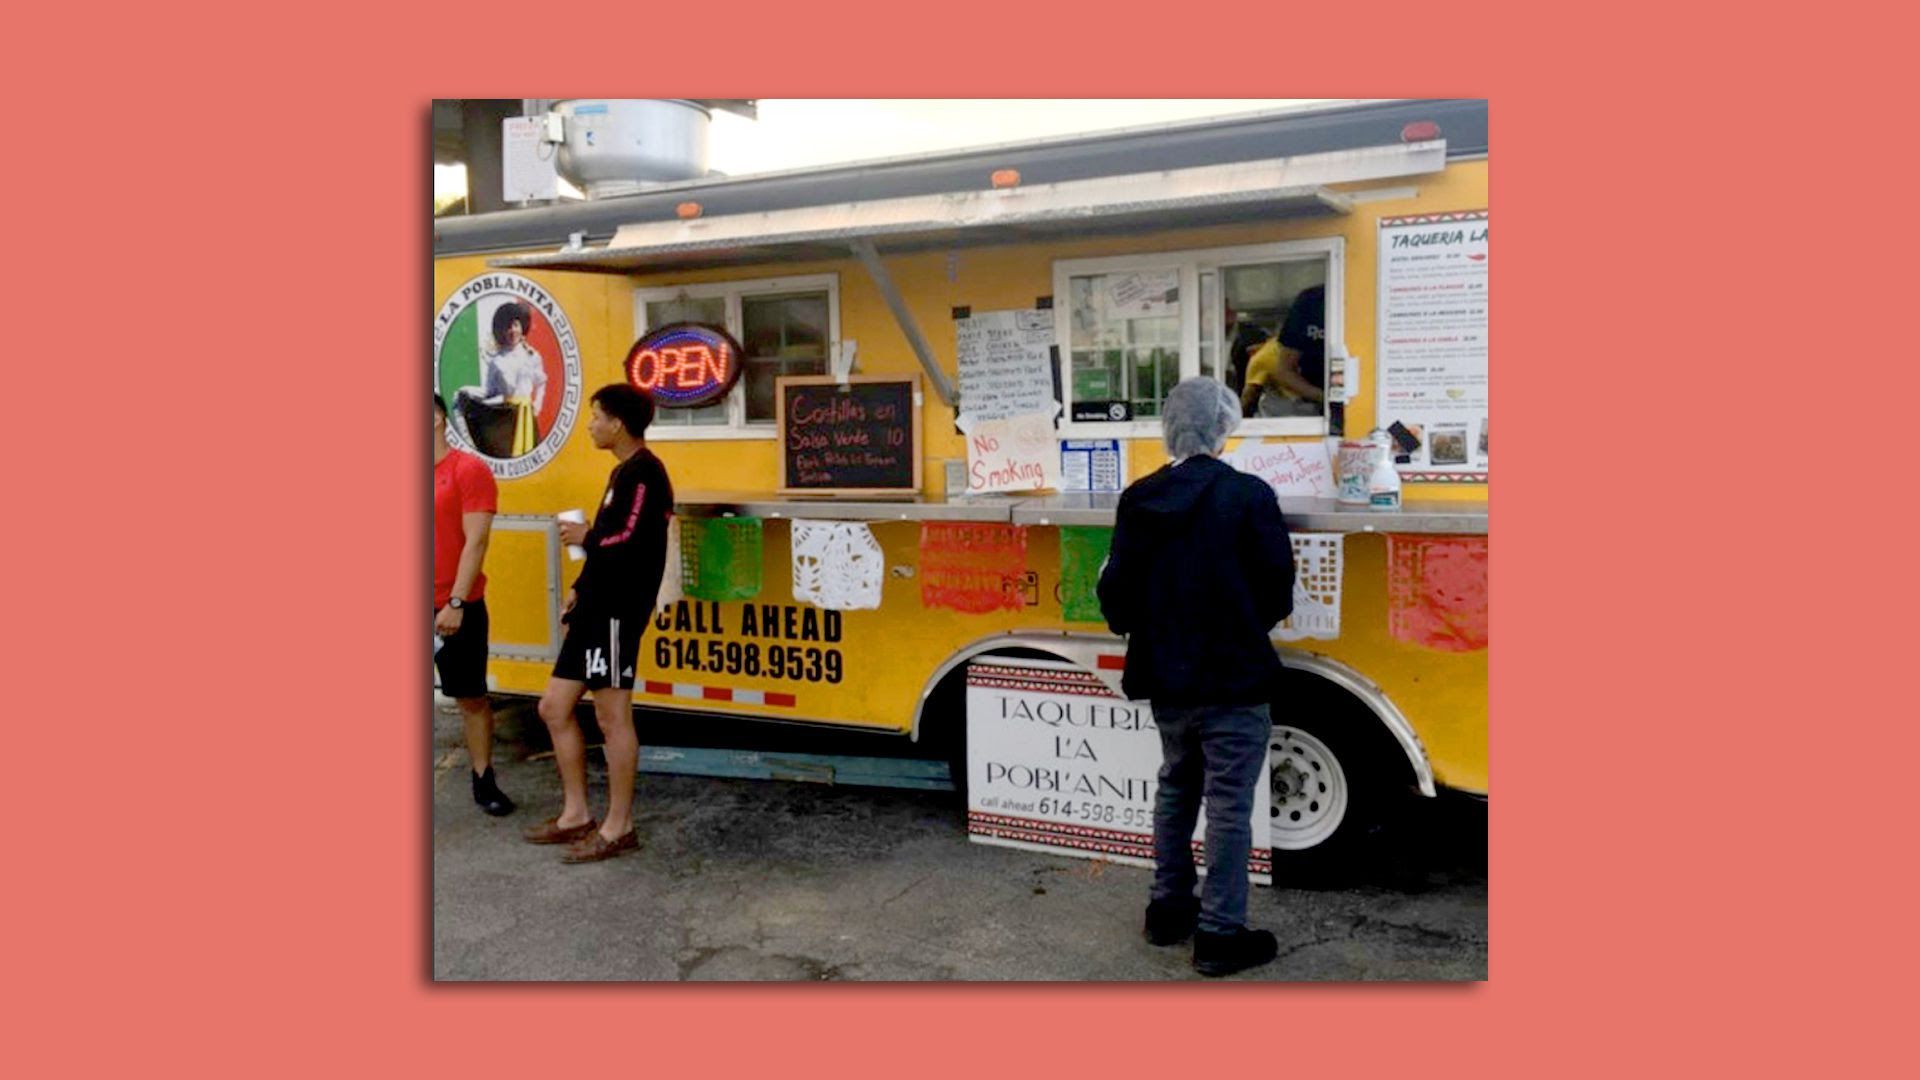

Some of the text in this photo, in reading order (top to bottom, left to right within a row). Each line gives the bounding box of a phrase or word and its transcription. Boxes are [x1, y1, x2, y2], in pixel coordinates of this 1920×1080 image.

[1391, 228, 1488, 249] TAQUERIA LA
[441, 276, 554, 324] LA POBLANITA
[632, 342, 727, 389] OPEN
[791, 395, 896, 425] Costillas en
[790, 426, 829, 449] Salsa
[834, 430, 869, 447] Verde
[973, 434, 999, 456] No
[1251, 445, 1296, 472] Closed
[656, 600, 842, 642] CALL AHEAD
[655, 636, 843, 684] 614.598.9539
[987, 762, 1158, 802] POBL'ANIT
[980, 796, 1154, 828] call ahead 614-598-95
